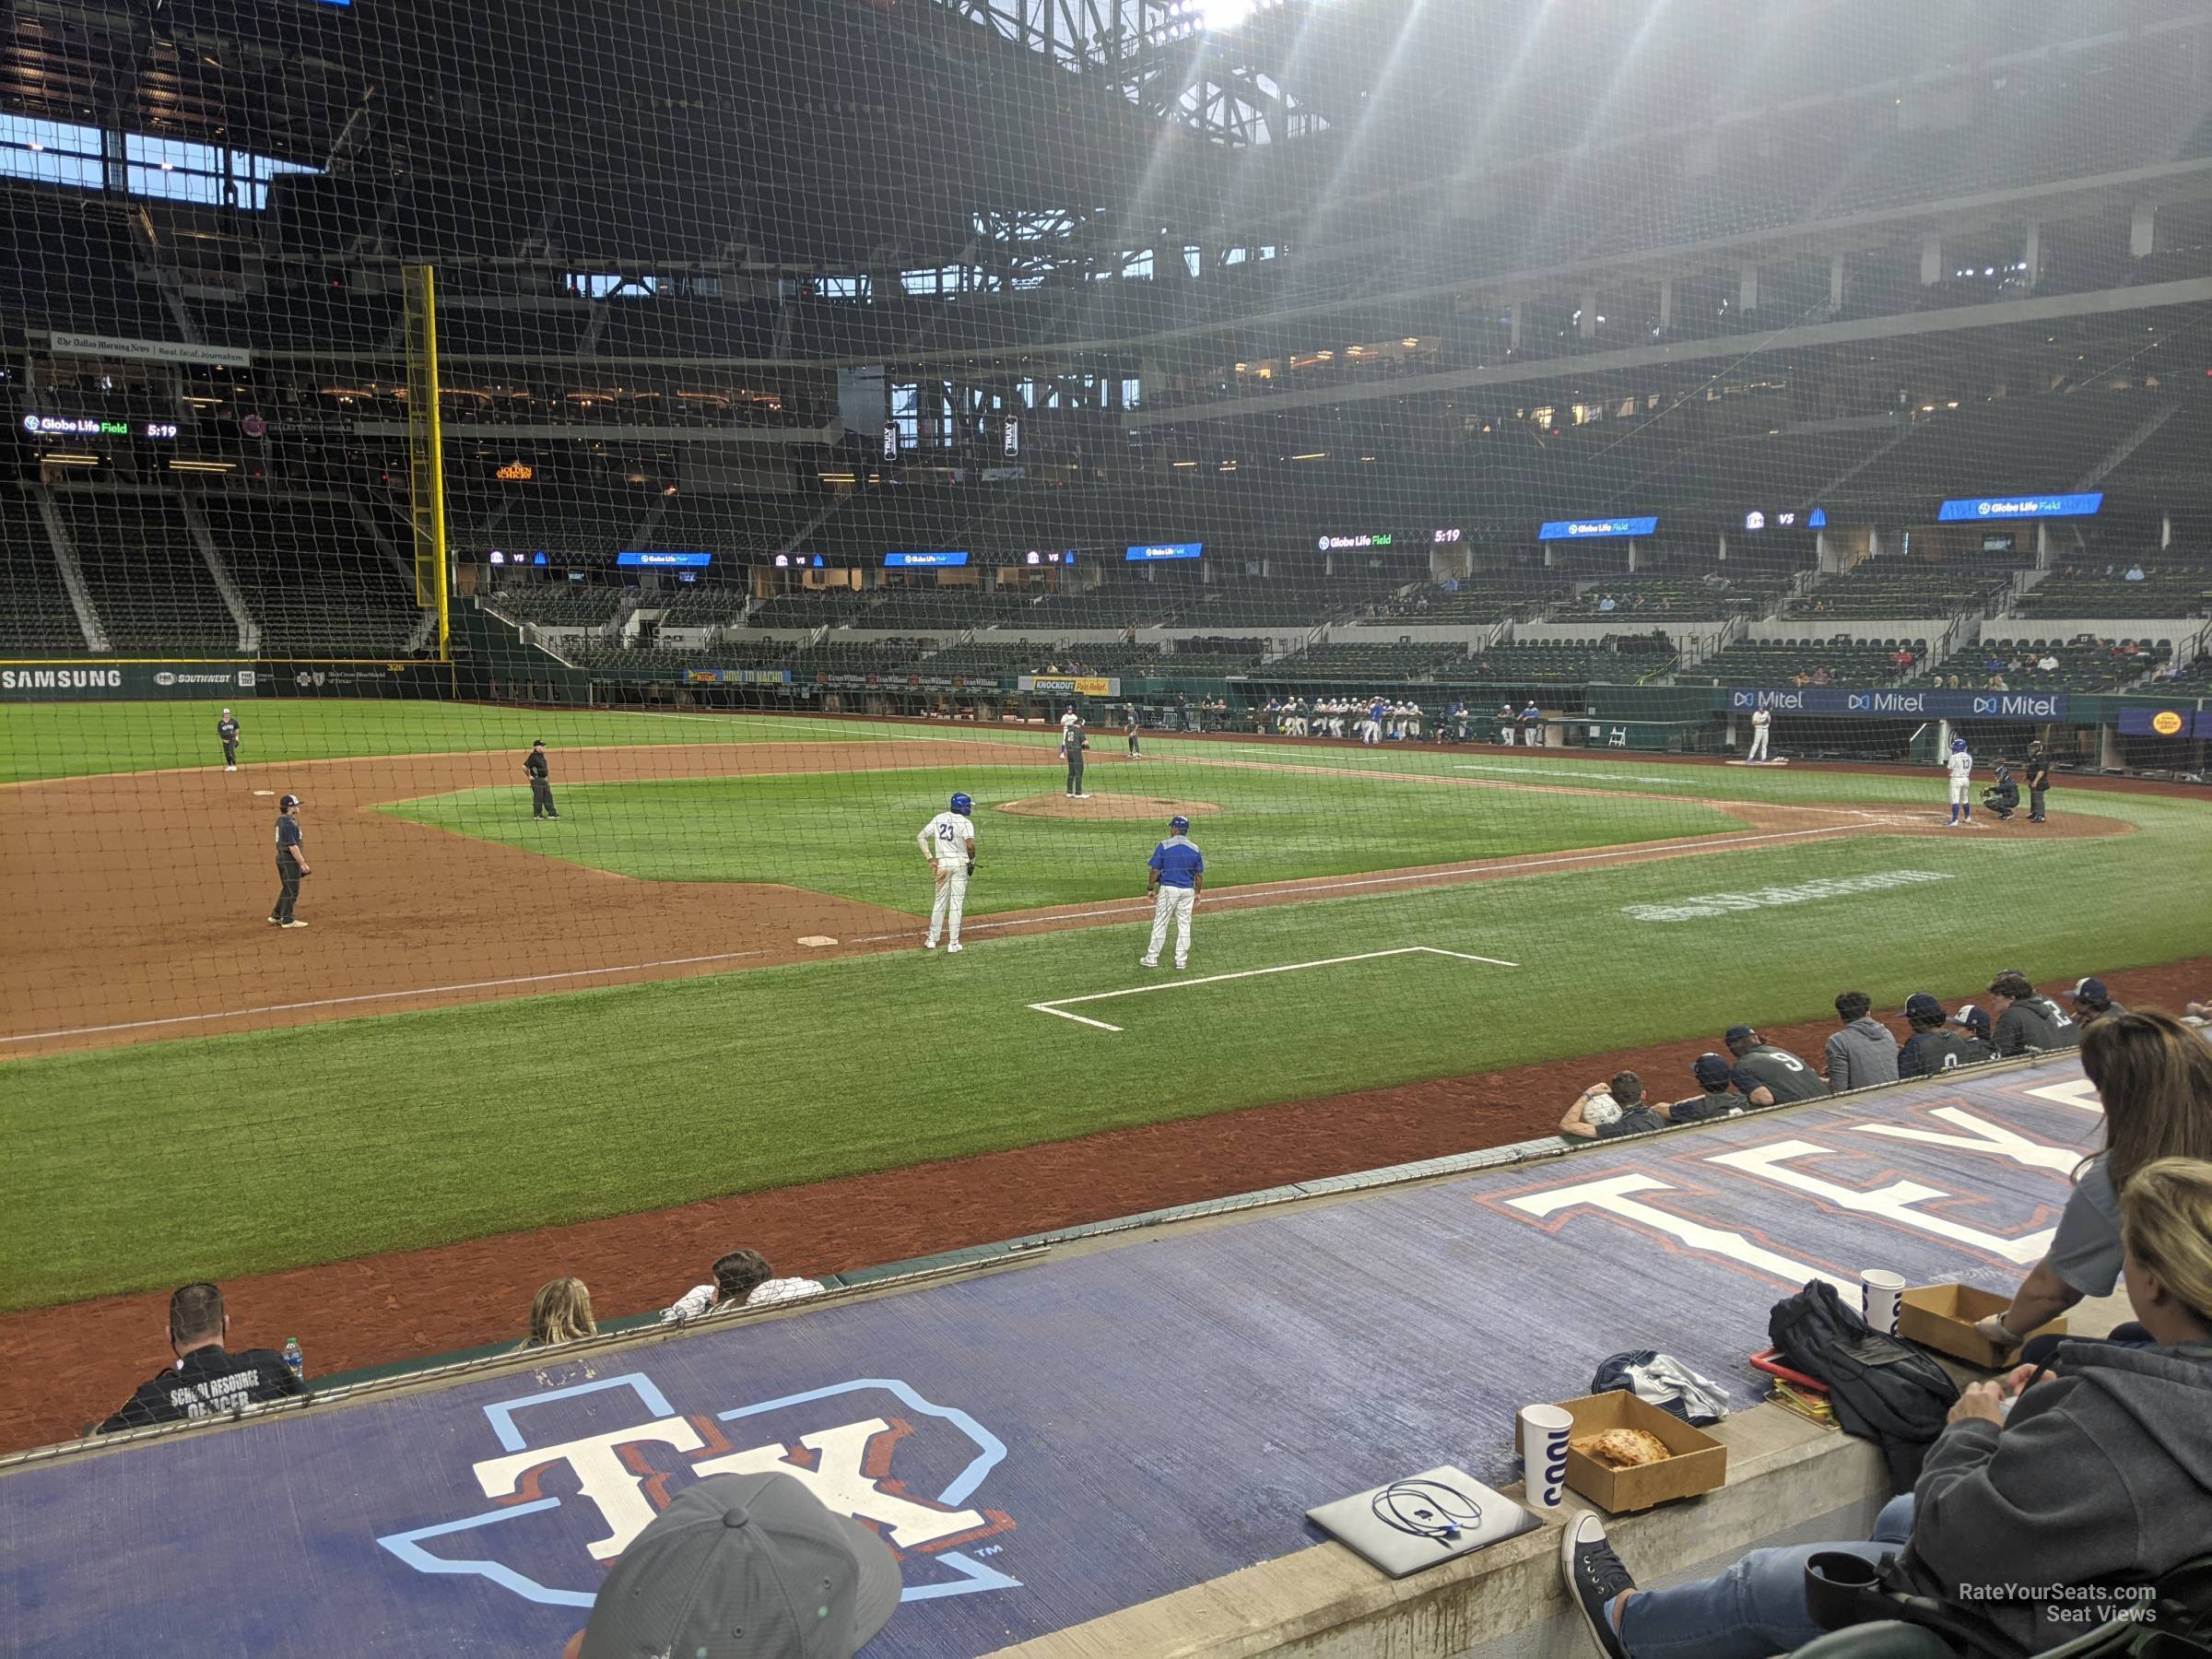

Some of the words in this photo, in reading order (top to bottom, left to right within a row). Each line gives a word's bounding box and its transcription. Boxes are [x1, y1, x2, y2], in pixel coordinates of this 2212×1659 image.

[57, 337, 72, 347] The
[74, 338, 97, 348] Dallas
[98, 340, 130, 352] Morning
[131, 343, 150, 353] News
[159, 347, 178, 357] Real.
[201, 351, 245, 362] Journalism.
[41, 418, 76, 430] Globe
[78, 420, 100, 432] Life
[101, 423, 127, 434] Field
[147, 425, 177, 437] 5:19
[1992, 503, 2018, 512] Globe
[2019, 502, 2038, 512] Life
[2039, 501, 2061, 512] Field
[1578, 524, 1598, 533] Globe
[1598, 523, 1612, 532] Life
[1612, 522, 1629, 532] Field
[1331, 536, 1354, 547] Globe
[1355, 535, 1371, 546] Life
[1371, 535, 1392, 546] Field
[1434, 529, 1460, 542] 5:19
[387, 664, 405, 672] 326
[3, 670, 121, 688] SAMSUNG
[178, 674, 231, 683] SOUTHWEST
[723, 670, 742, 683] HOW
[745, 670, 755, 683] TO
[757, 670, 782, 683] NACHO
[1036, 681, 1075, 690] KNOCKOUT
[1077, 682, 1088, 691] Pain
[1759, 691, 1803, 709] Mitel
[1875, 693, 1924, 712] Mitel
[2002, 696, 2056, 715] Mitel
[939, 823, 954, 842] 23
[1770, 1052, 1804, 1072] 9
[210, 1370, 260, 1397] RESOURCE
[973, 1544, 1004, 1558] TM
